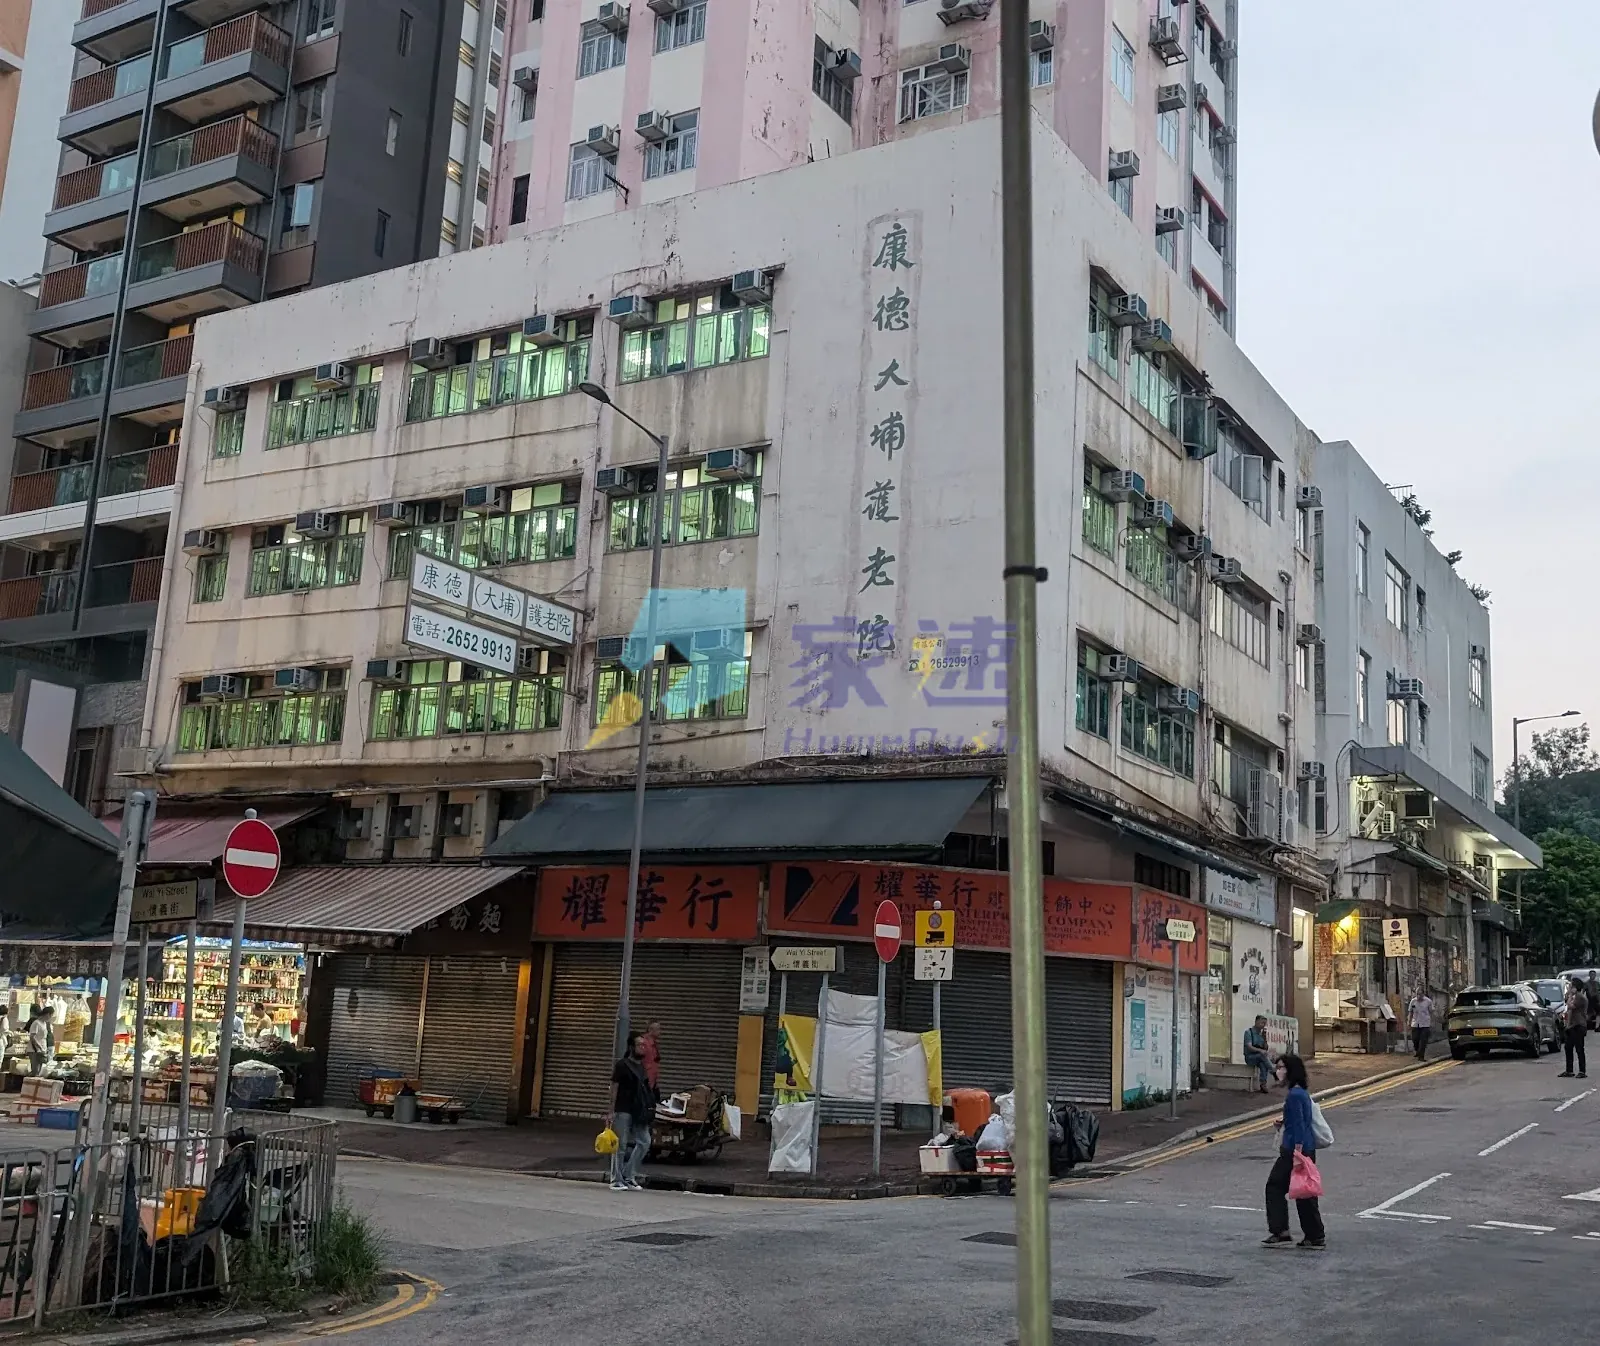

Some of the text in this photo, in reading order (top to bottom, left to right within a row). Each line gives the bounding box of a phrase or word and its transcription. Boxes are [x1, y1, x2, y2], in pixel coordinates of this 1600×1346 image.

[482, 636, 513, 664] 9913
[930, 654, 980, 669] 26529913
[143, 885, 188, 899] Wai Yi Street
[873, 870, 979, 907] 耀華行
[561, 871, 733, 933] 耀華行
[939, 950, 947, 961] 7
[939, 967, 946, 978] 7
